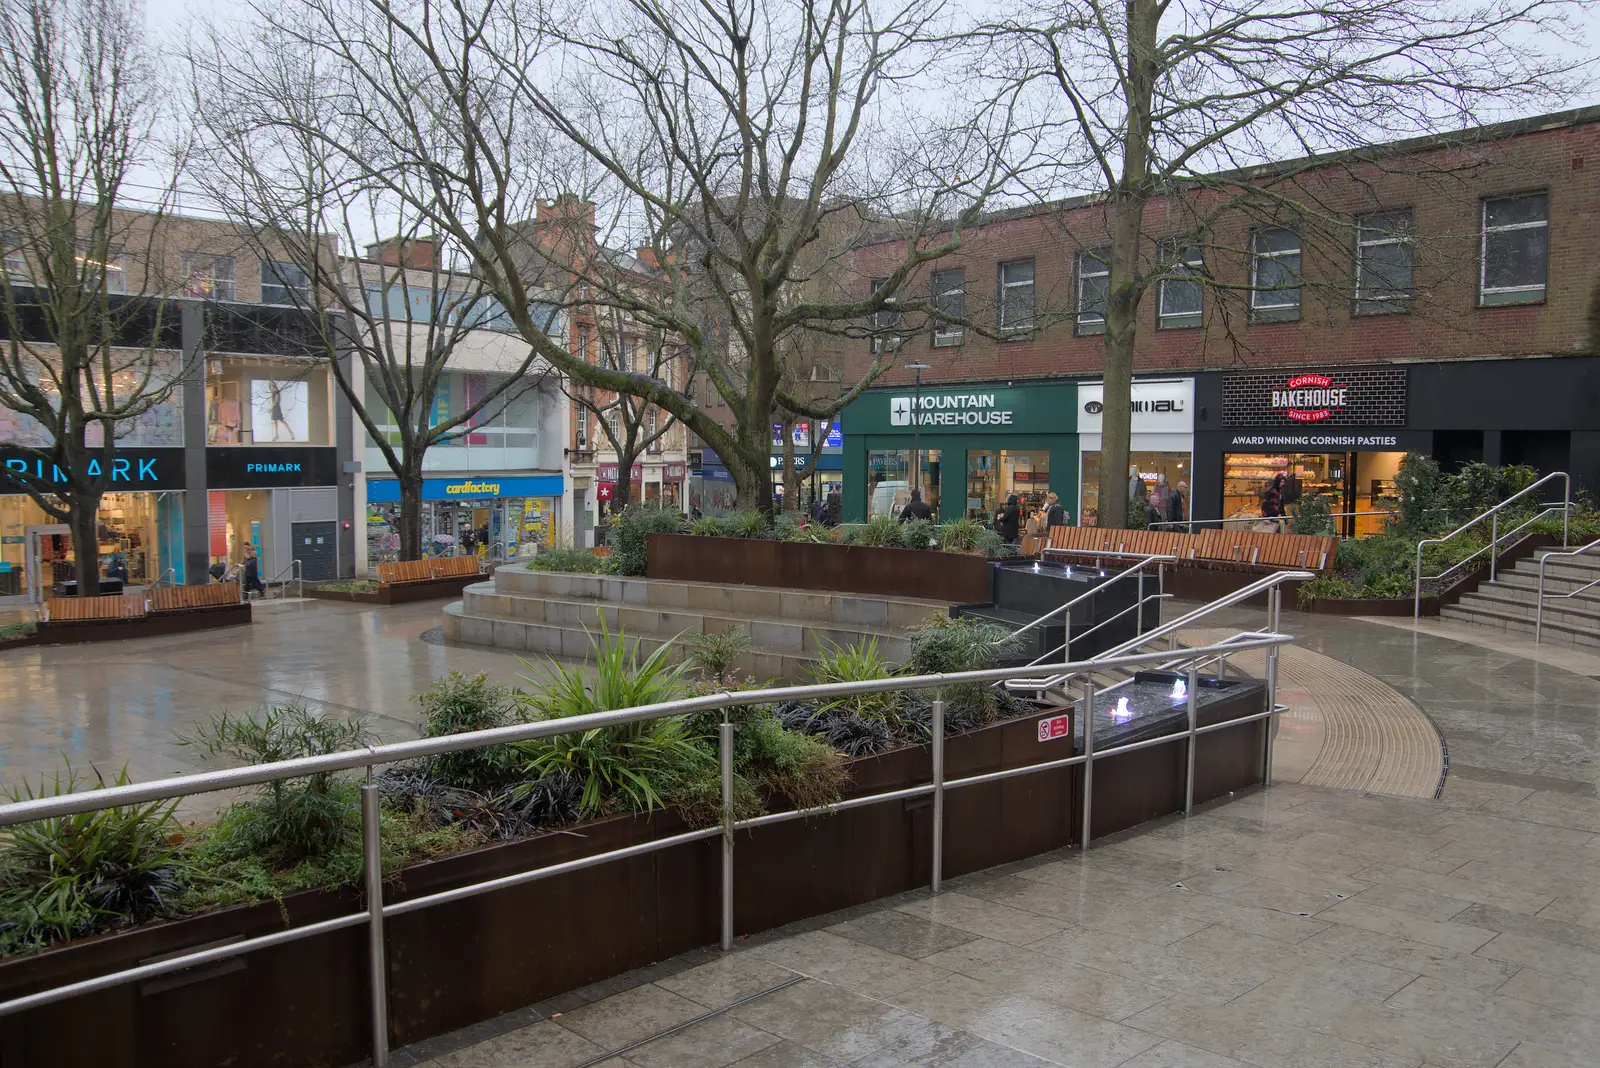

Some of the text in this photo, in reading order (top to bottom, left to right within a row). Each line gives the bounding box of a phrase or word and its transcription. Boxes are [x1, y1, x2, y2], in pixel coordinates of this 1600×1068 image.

[1290, 376, 1329, 388] CORNISH
[911, 394, 995, 410] MOUNTAIN
[1272, 388, 1347, 408] BAKEHOUSE
[911, 411, 1013, 426] WAREHOUSE
[1288, 410, 1329, 421] SINCE 1983
[1231, 436, 1397, 446] AWARD WINNING CORNISH PASTIES
[246, 463, 302, 473] PRIMARK
[446, 481, 500, 495] cardfactory
